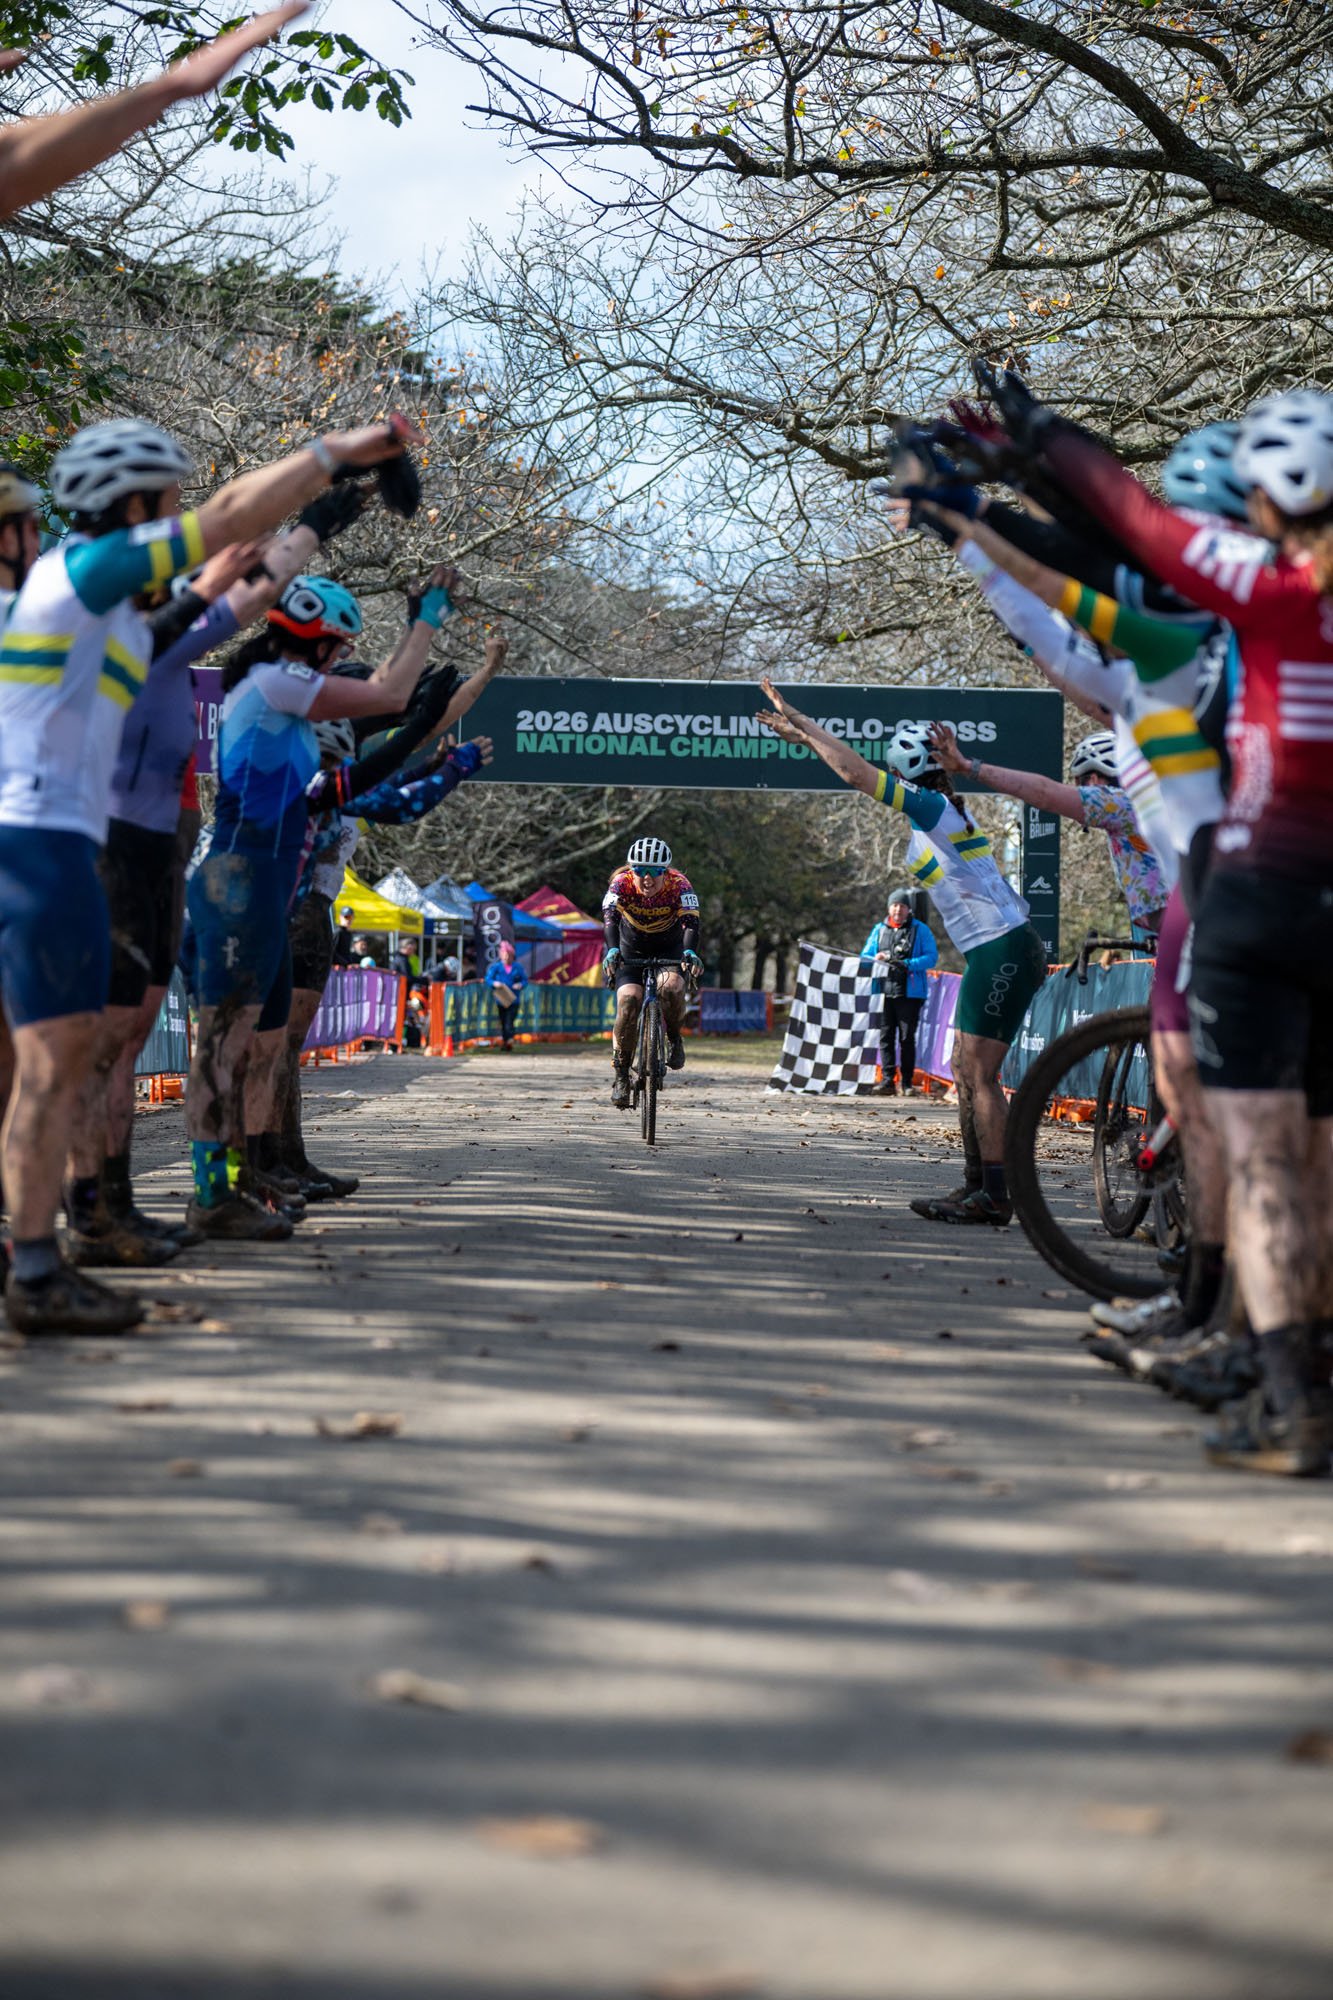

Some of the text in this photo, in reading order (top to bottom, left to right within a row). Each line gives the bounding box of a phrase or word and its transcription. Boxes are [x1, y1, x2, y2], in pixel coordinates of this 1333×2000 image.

[516, 710, 589, 732] 2026
[789, 717, 997, 742] CLO-OSS
[516, 732, 888, 761] NATIONAL CHAMPIOHI
[1029, 806, 1040, 822] CX
[684, 895, 697, 906] 115
[481, 905, 502, 962] edla
[984, 963, 1019, 1016] pedla
